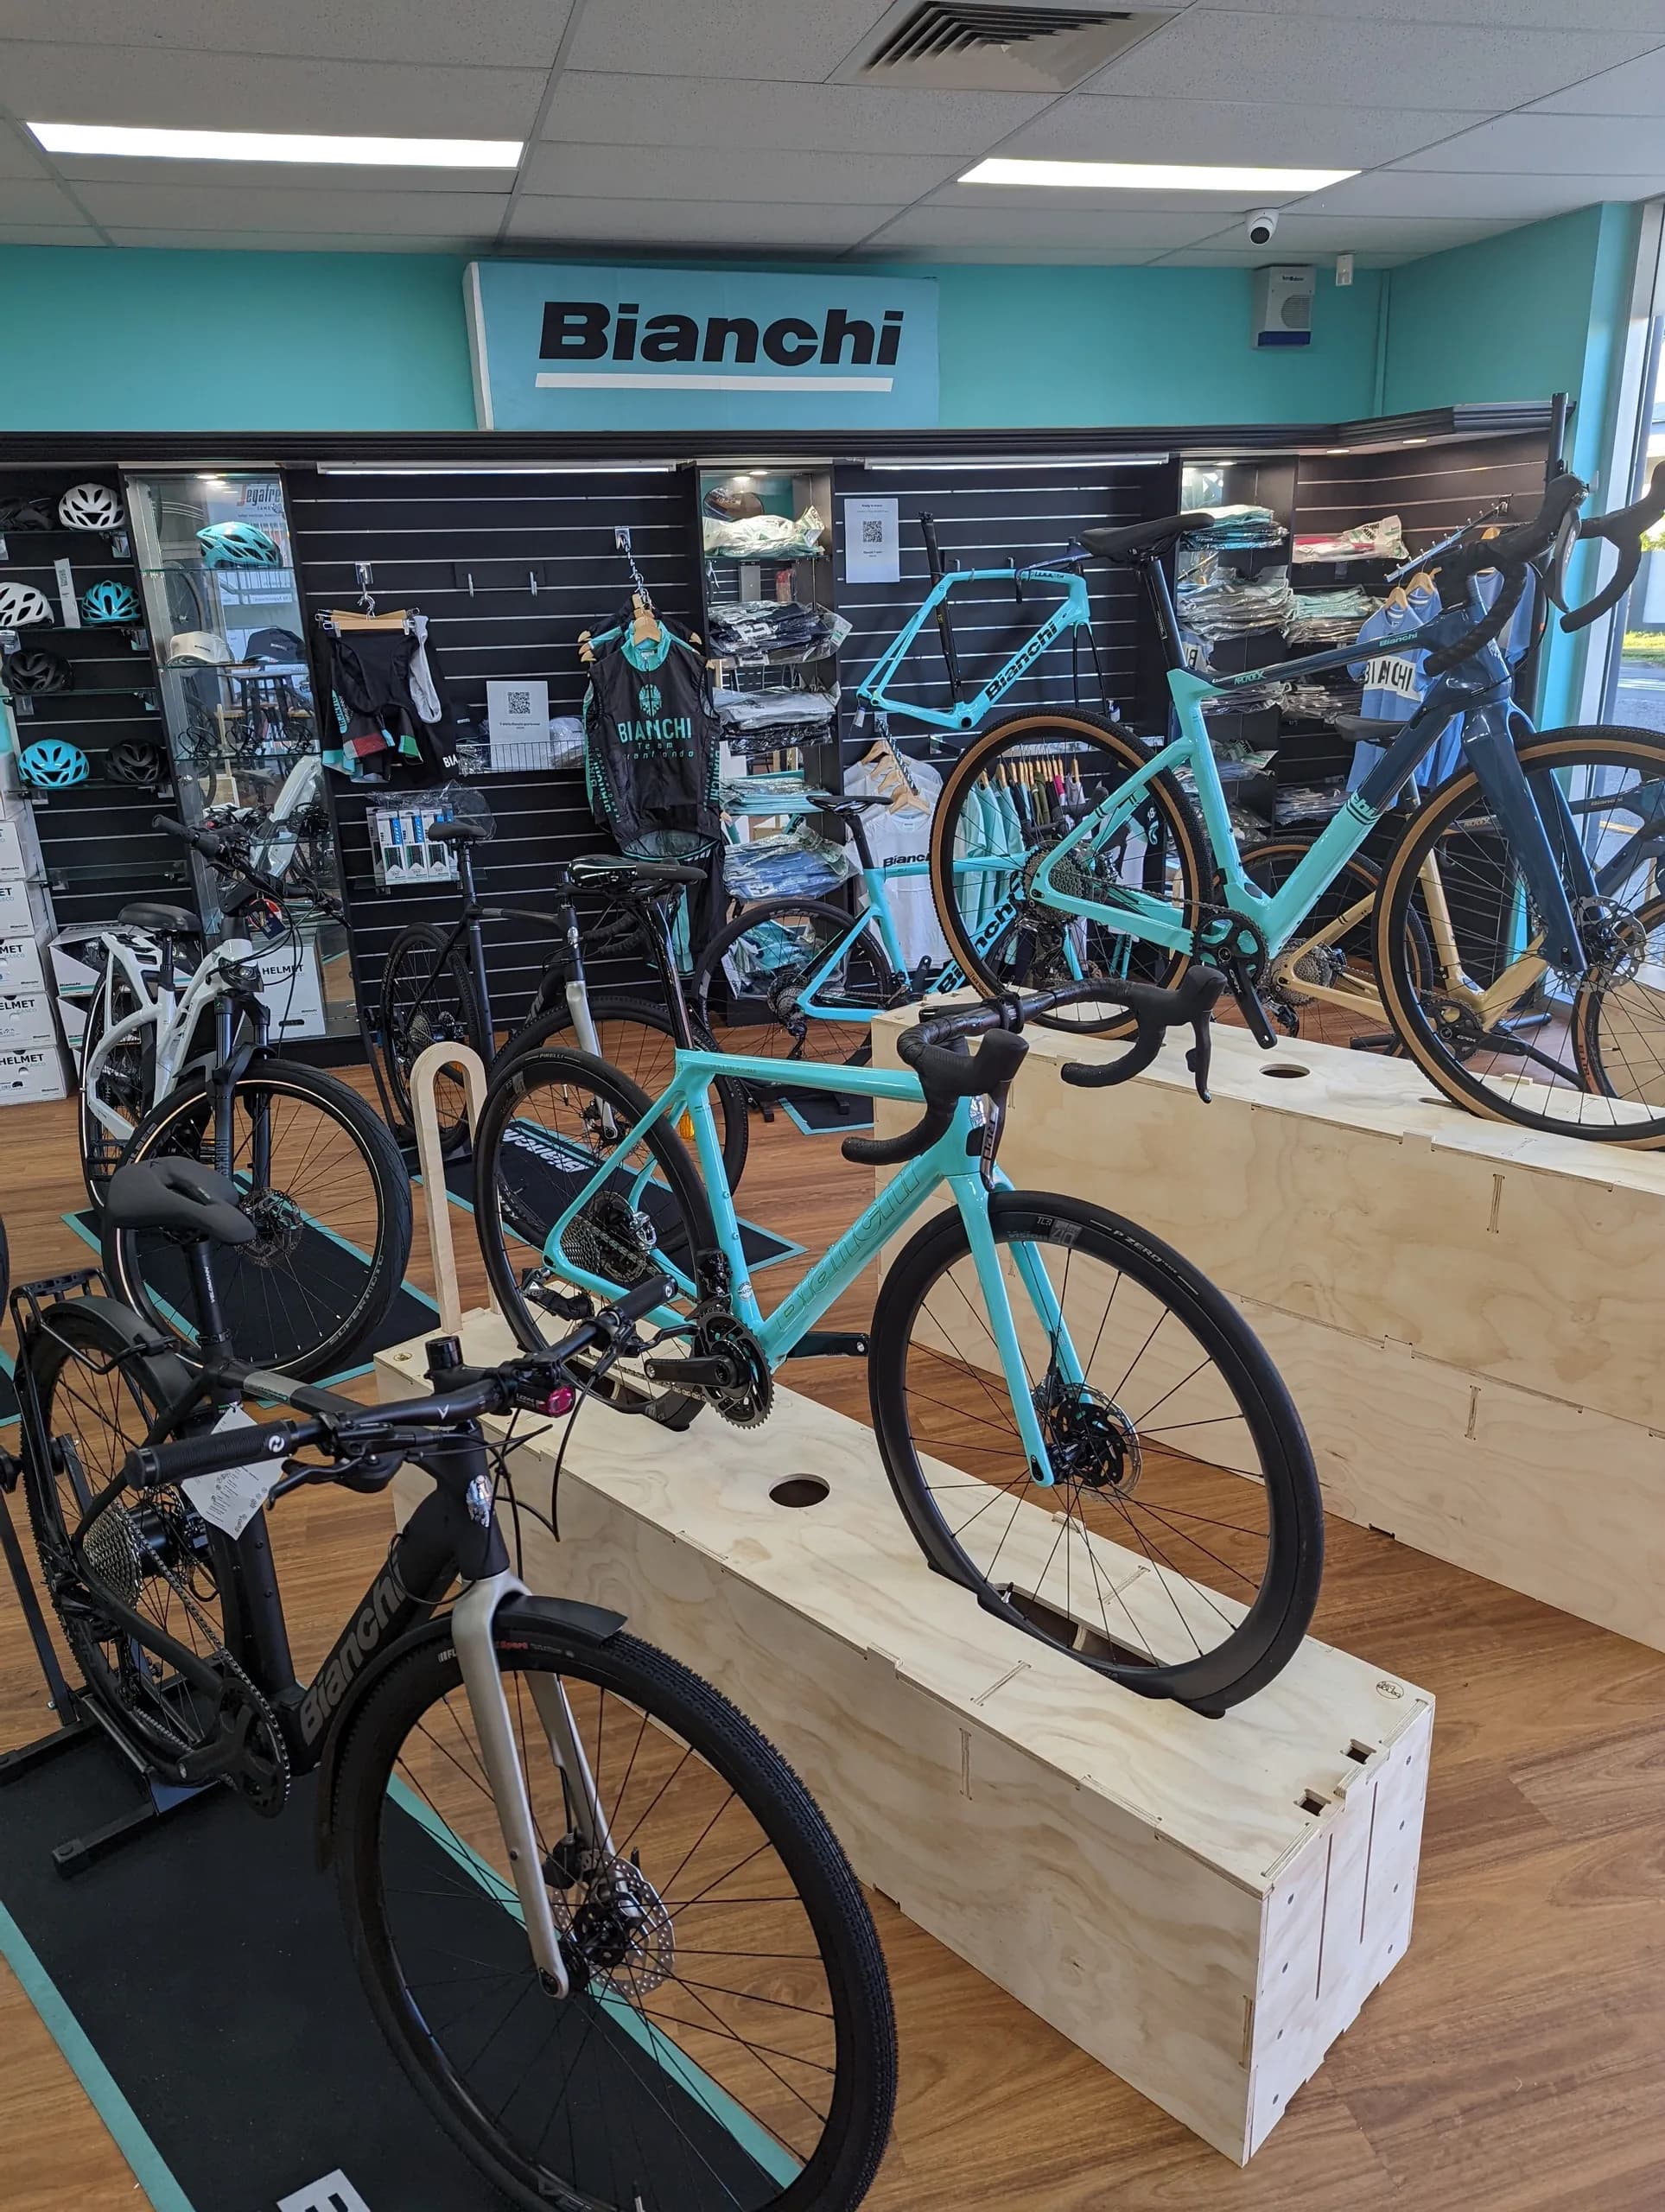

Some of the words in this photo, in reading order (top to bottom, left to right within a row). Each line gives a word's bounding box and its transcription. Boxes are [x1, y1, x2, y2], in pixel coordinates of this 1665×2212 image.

[539, 302, 905, 367] Bianchi
[985, 621, 1058, 702] Bianchi
[1379, 632, 1418, 647] Bianchi
[617, 717, 692, 744] BIANCHI
[501, 1128, 590, 1173] Bianch
[776, 1157, 920, 1332] Bianchi
[1112, 1229, 1125, 1237] P
[1124, 1236, 1164, 1263] ZERO
[299, 1552, 408, 1747] Bianchi
